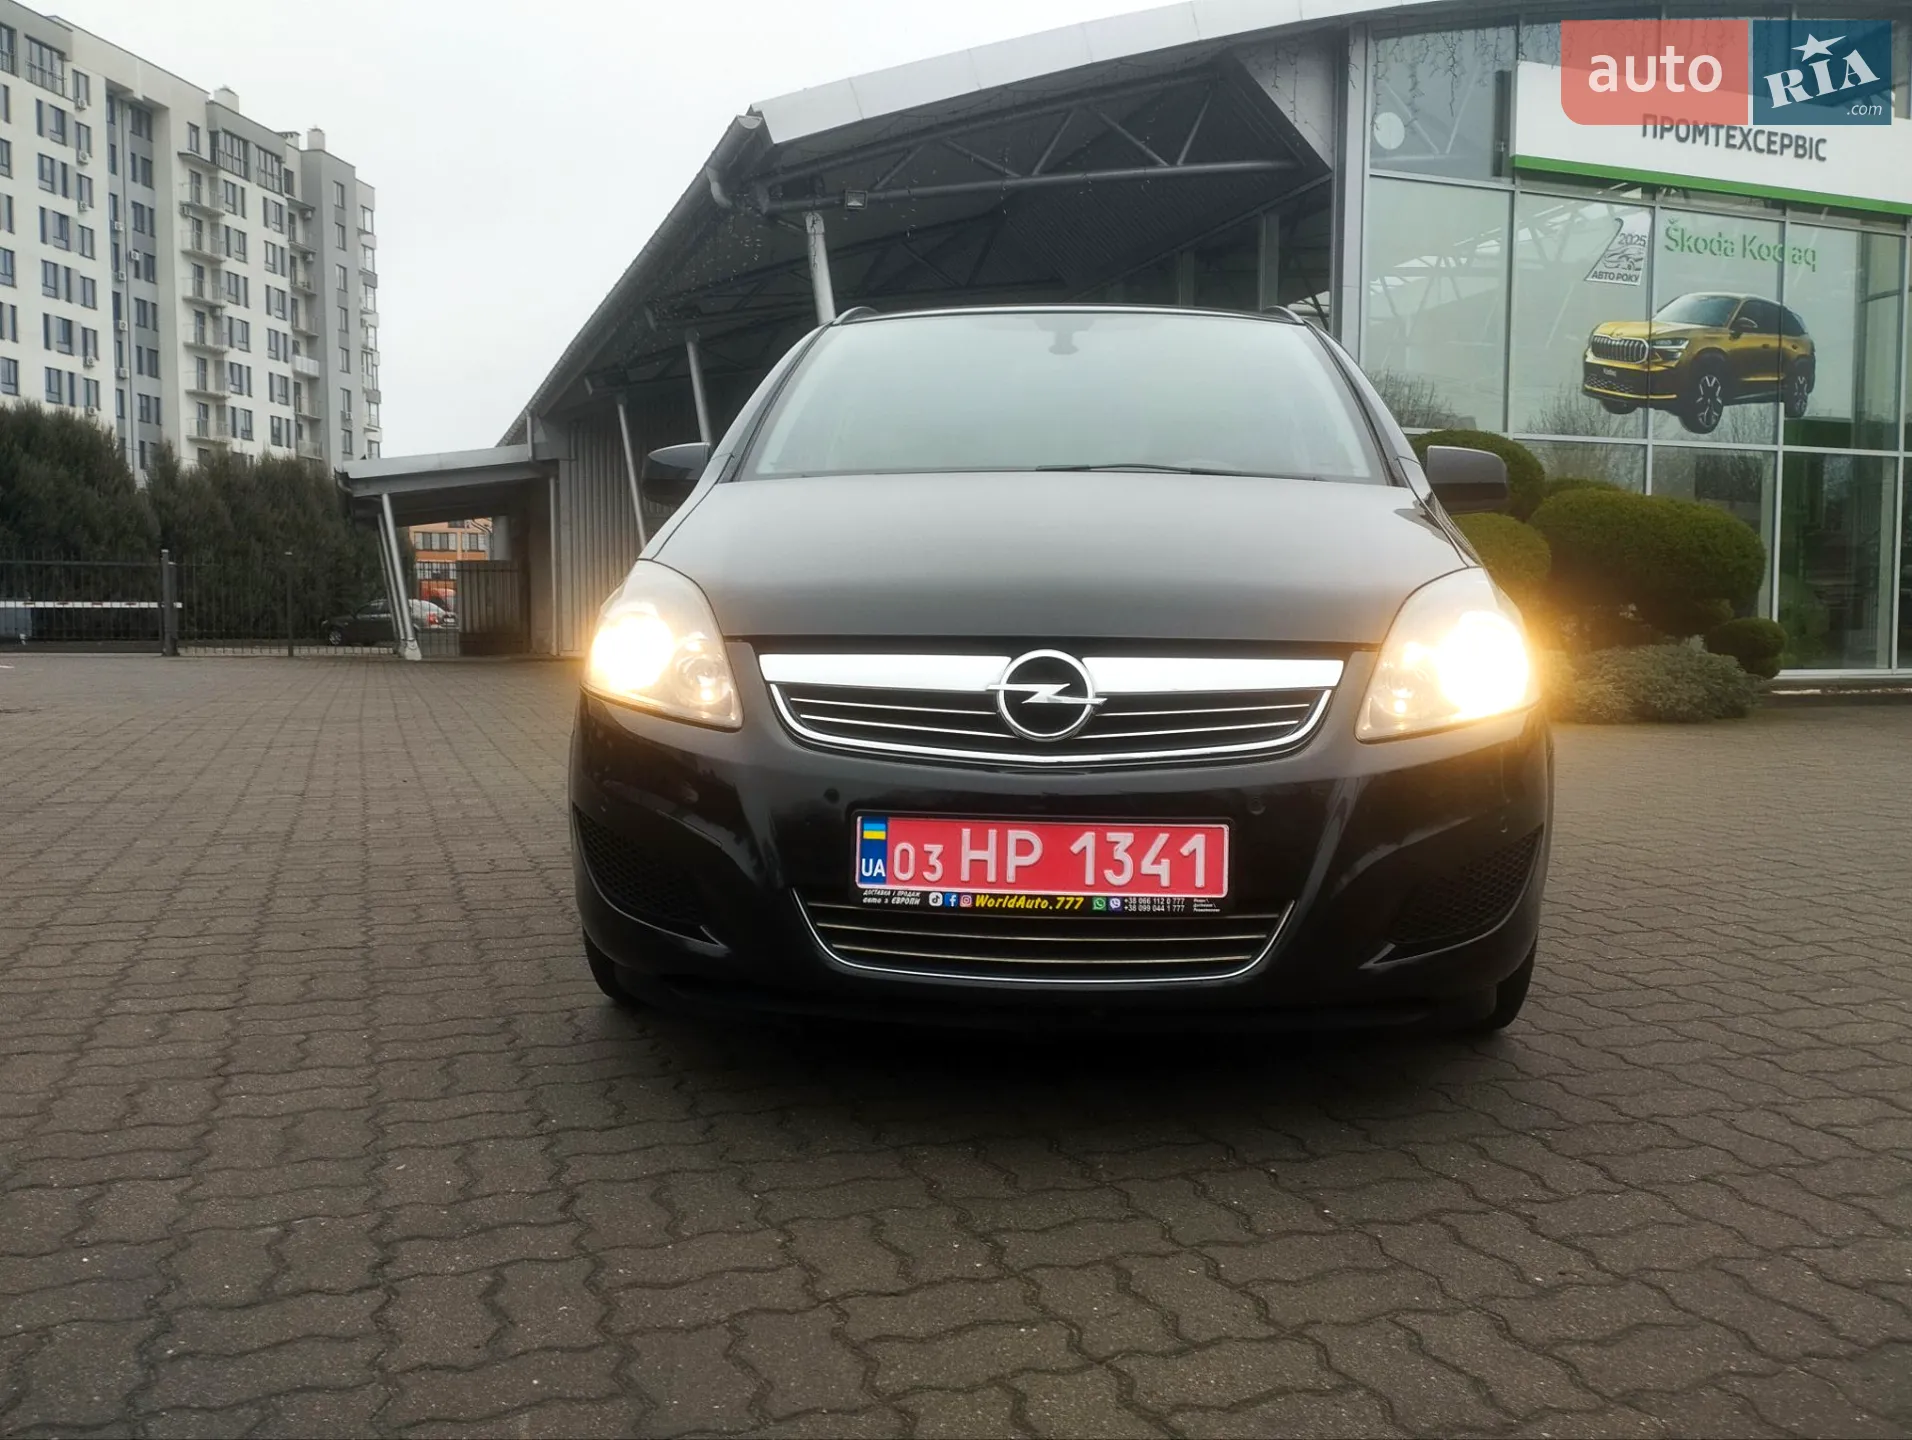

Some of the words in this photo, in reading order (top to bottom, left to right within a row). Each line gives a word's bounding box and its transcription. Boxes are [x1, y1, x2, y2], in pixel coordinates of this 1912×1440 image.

[1642, 113, 1828, 162] ПРОМТЕХСЕРВІС
[1618, 233, 1647, 247] 2025
[1664, 218, 1735, 257] Škoda
[1592, 270, 1615, 281] АВТО
[1616, 272, 1640, 283] РОКУ
[893, 842, 944, 882] 03
[960, 828, 1043, 883] HP
[1069, 831, 1206, 888] 1341
[861, 858, 886, 877] UA
[975, 894, 1085, 910] WorldAuto.777
[1124, 904, 1137, 912] +38
